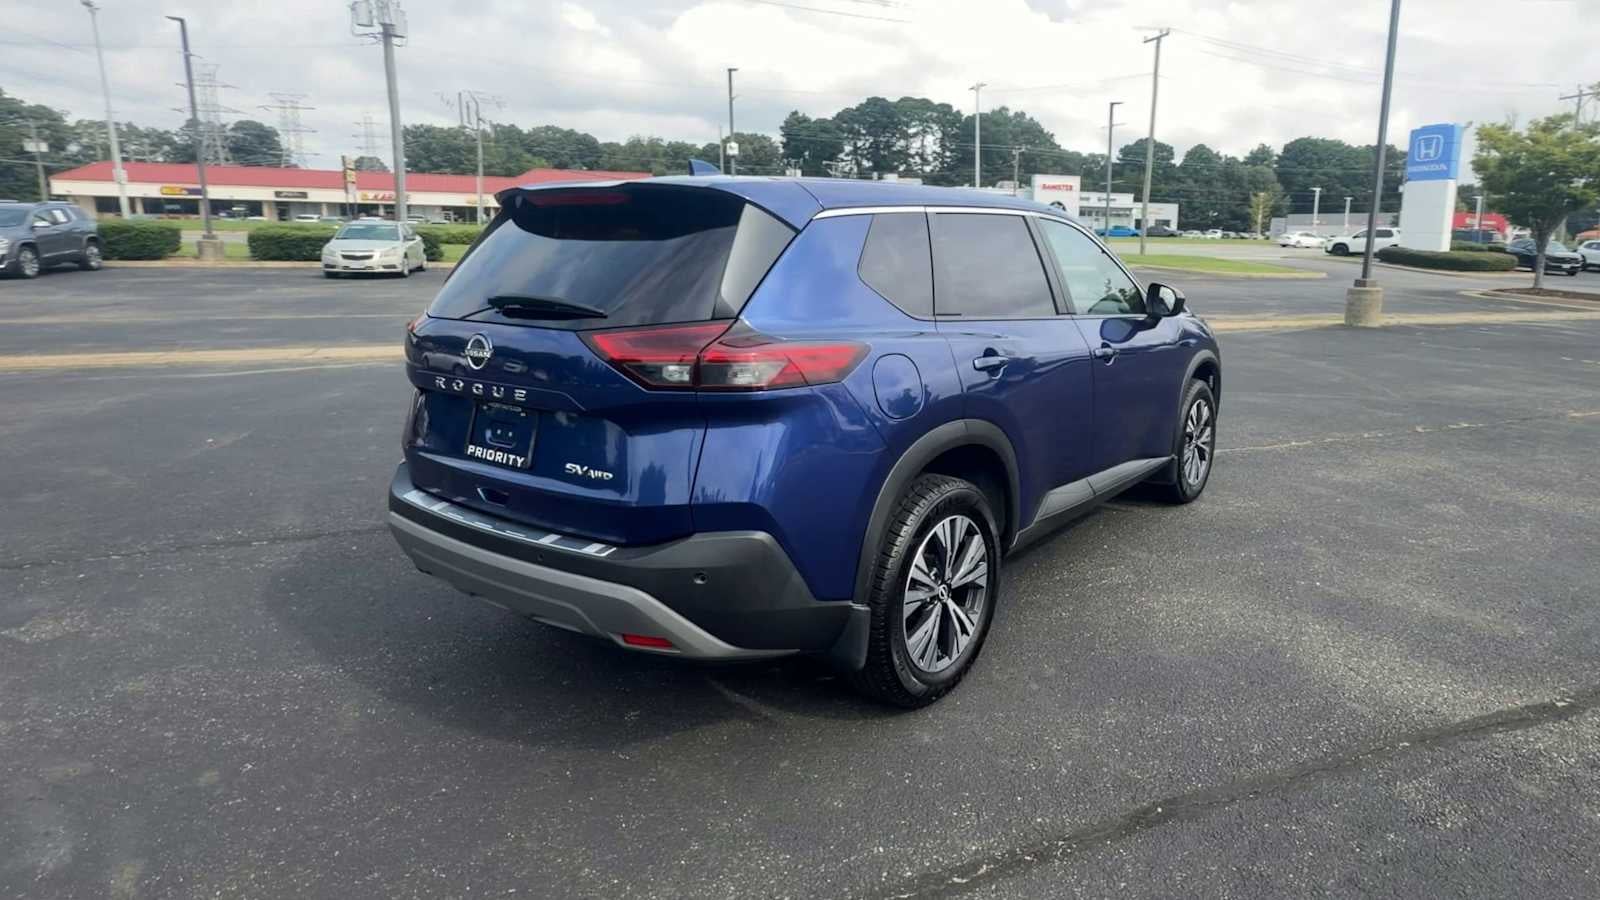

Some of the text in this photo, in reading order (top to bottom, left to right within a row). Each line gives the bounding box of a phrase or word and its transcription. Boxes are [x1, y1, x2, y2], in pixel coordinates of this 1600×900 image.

[435, 376, 526, 401] ROGUE
[467, 444, 525, 468] PRIORITY
[565, 462, 589, 475] SV
